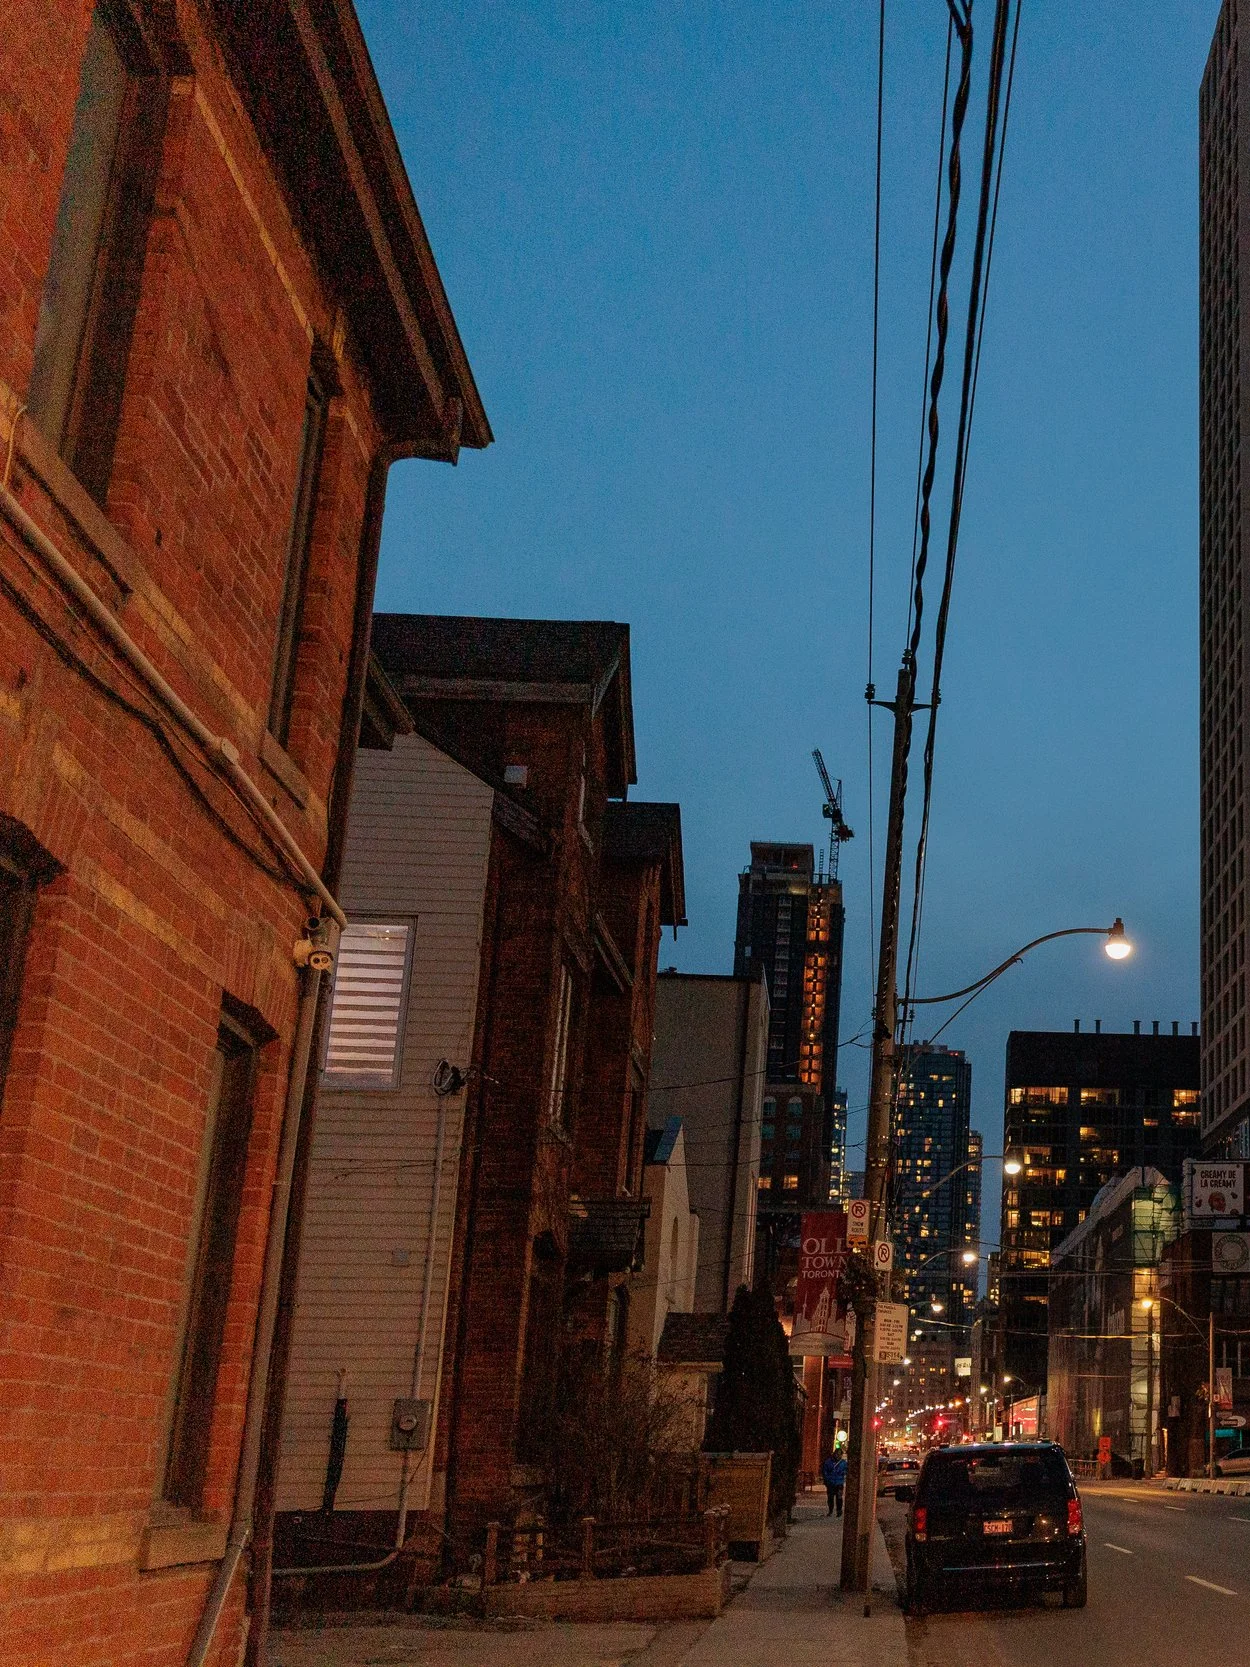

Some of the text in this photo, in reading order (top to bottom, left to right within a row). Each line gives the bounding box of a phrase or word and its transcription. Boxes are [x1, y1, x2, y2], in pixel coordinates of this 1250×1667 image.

[1200, 1170, 1236, 1179] CREAMY DE
[1200, 1179, 1237, 1189] LA CREAMY
[801, 1269, 845, 1279] TORONT
